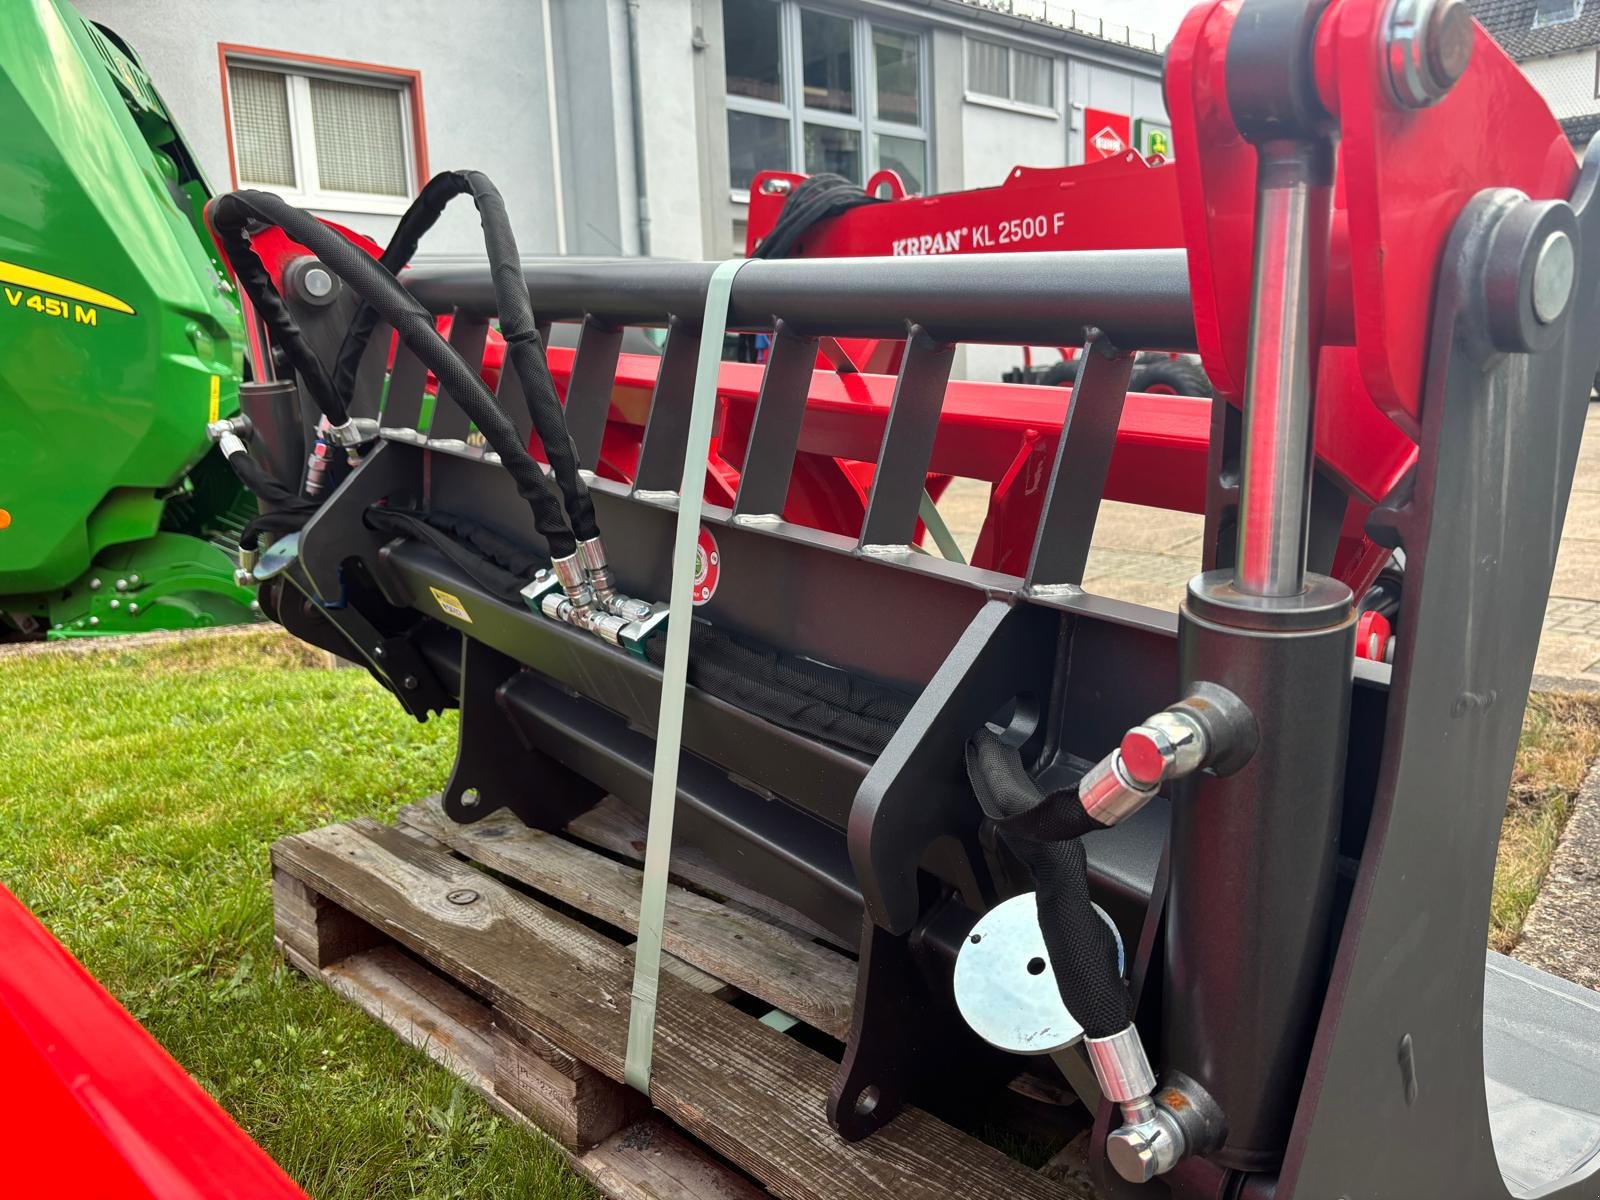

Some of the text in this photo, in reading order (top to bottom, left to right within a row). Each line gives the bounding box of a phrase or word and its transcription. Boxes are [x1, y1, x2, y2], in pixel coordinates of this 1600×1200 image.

[972, 225, 995, 248] KL
[998, 215, 1048, 244] 2500
[1053, 212, 1065, 235] F
[4, 287, 97, 327] V 451 M
